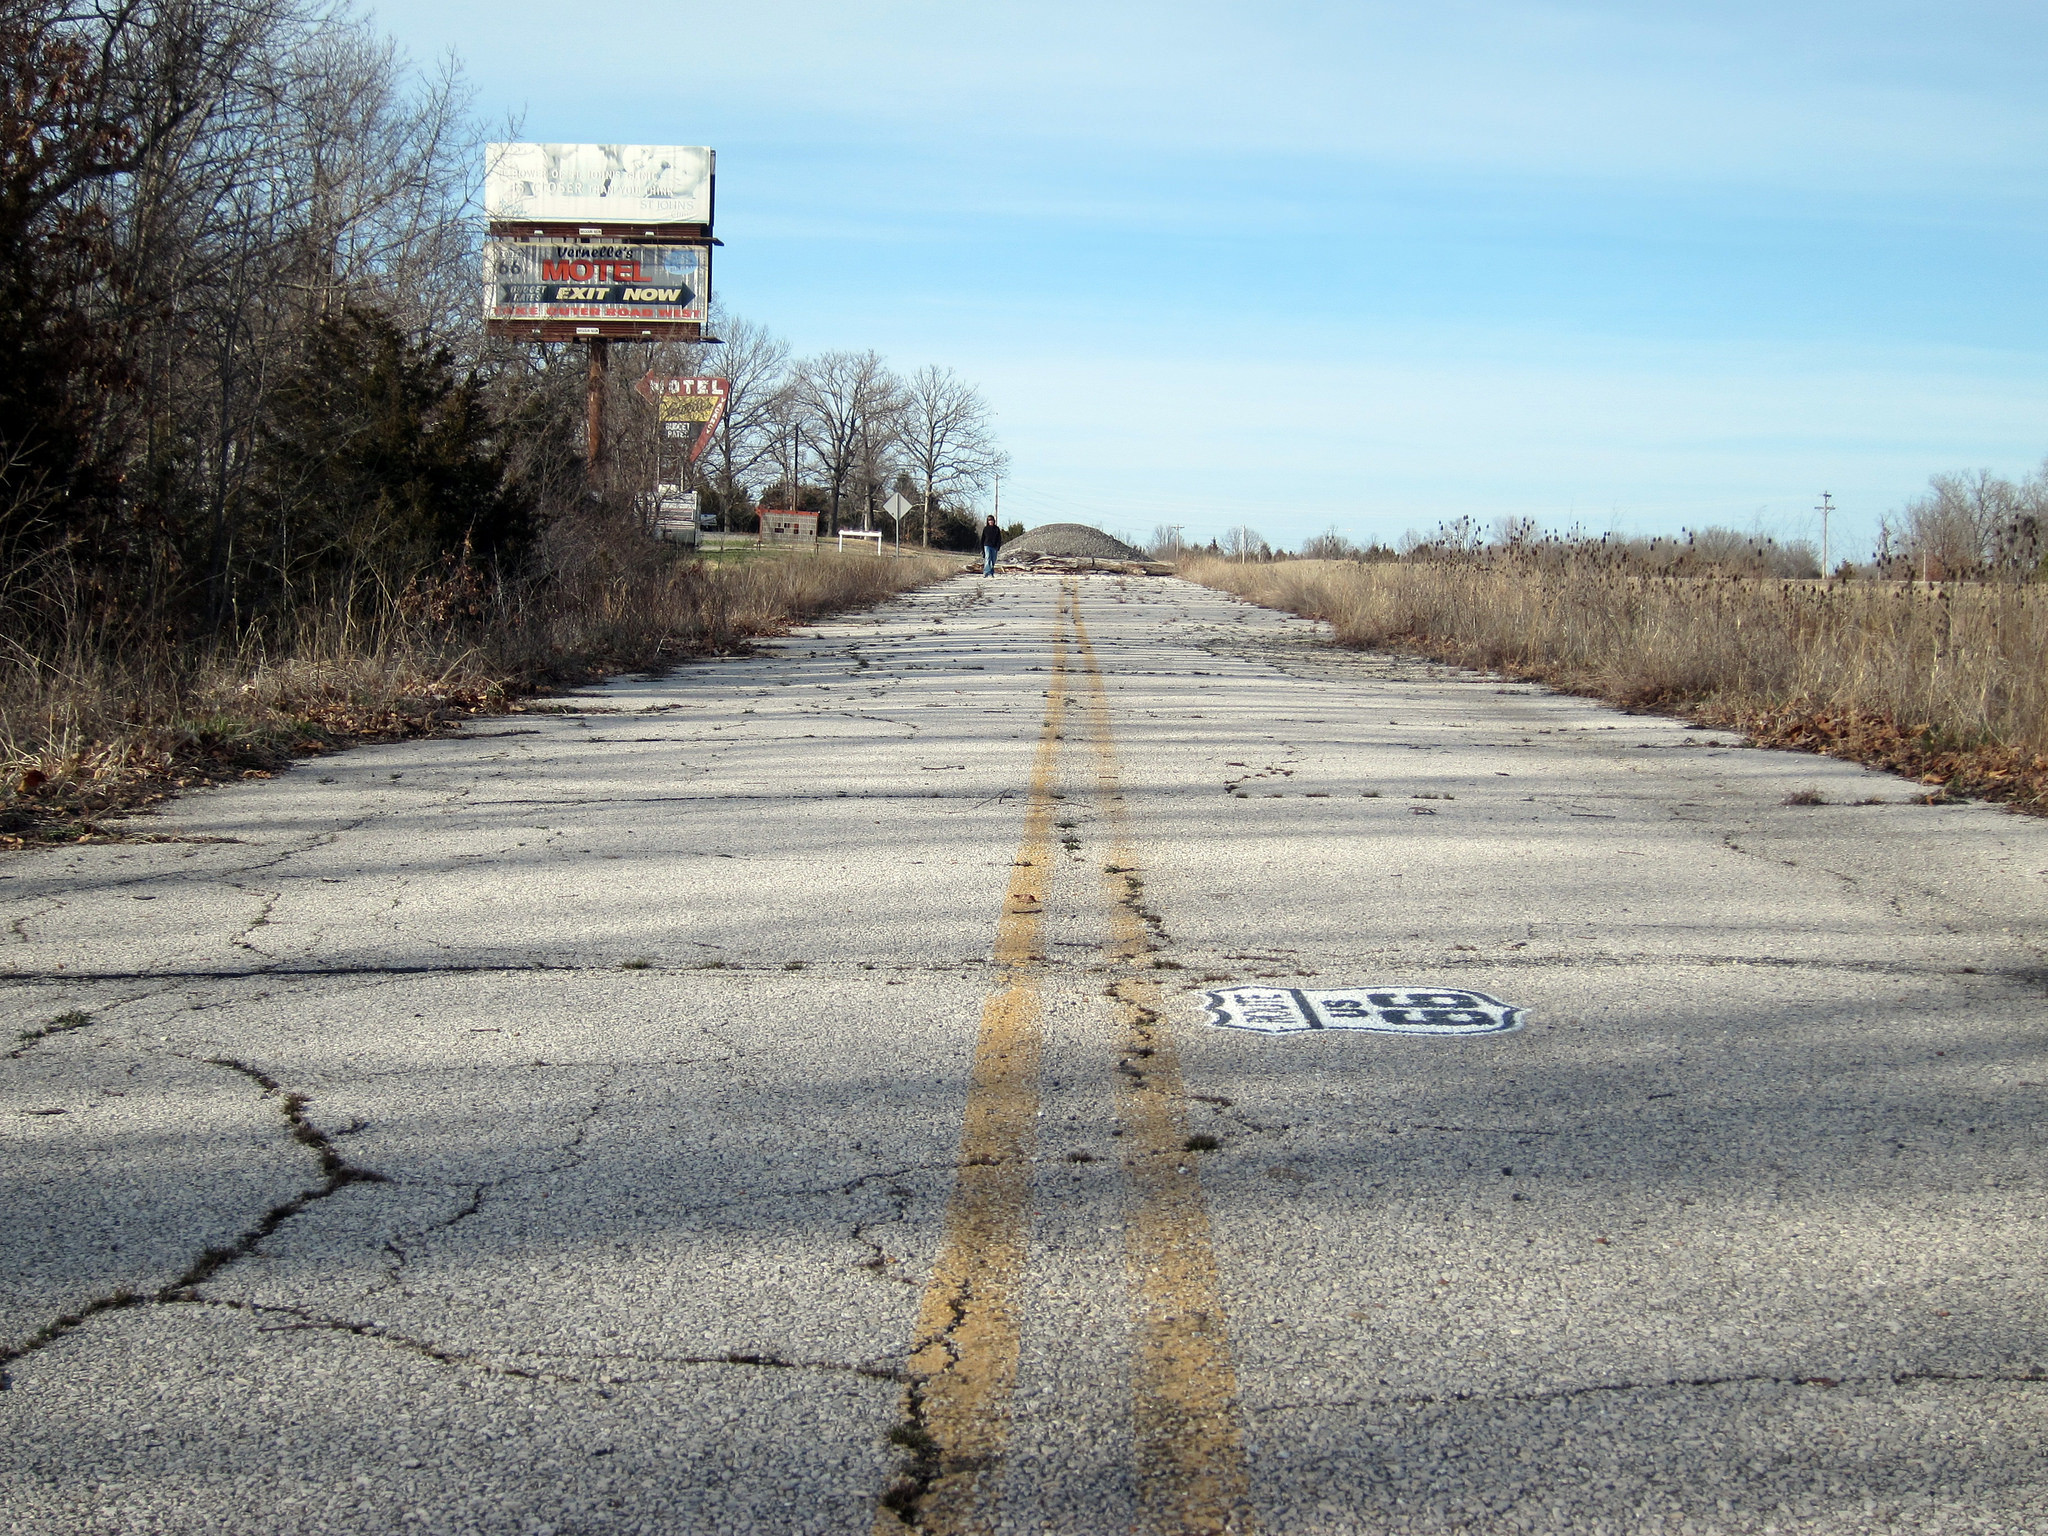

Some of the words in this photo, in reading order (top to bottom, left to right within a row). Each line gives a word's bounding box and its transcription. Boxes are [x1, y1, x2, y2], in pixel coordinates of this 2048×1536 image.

[512, 182, 526, 193] IS
[533, 182, 583, 194] CLOSER
[589, 184, 616, 195] THAN
[618, 185, 640, 196] YOU
[645, 185, 674, 197] THINK
[640, 200, 654, 210] ST
[557, 246, 634, 259] Vernelle's
[498, 259, 522, 275] 66
[542, 259, 653, 282] MOTEL
[510, 285, 547, 295] BUDGET
[513, 293, 542, 302] RATES
[556, 287, 610, 301] EXIT
[623, 288, 682, 302] NOW
[492, 306, 539, 316] TAKE
[546, 306, 601, 316] OUTER
[605, 307, 653, 317] ROAD
[658, 308, 701, 318] WEST
[650, 379, 724, 395] MOTEL
[706, 397, 727, 435] VACANCY
[665, 422, 690, 431] BUDGET
[1321, 999, 1369, 1018] US
[1367, 993, 1497, 1026] 66
